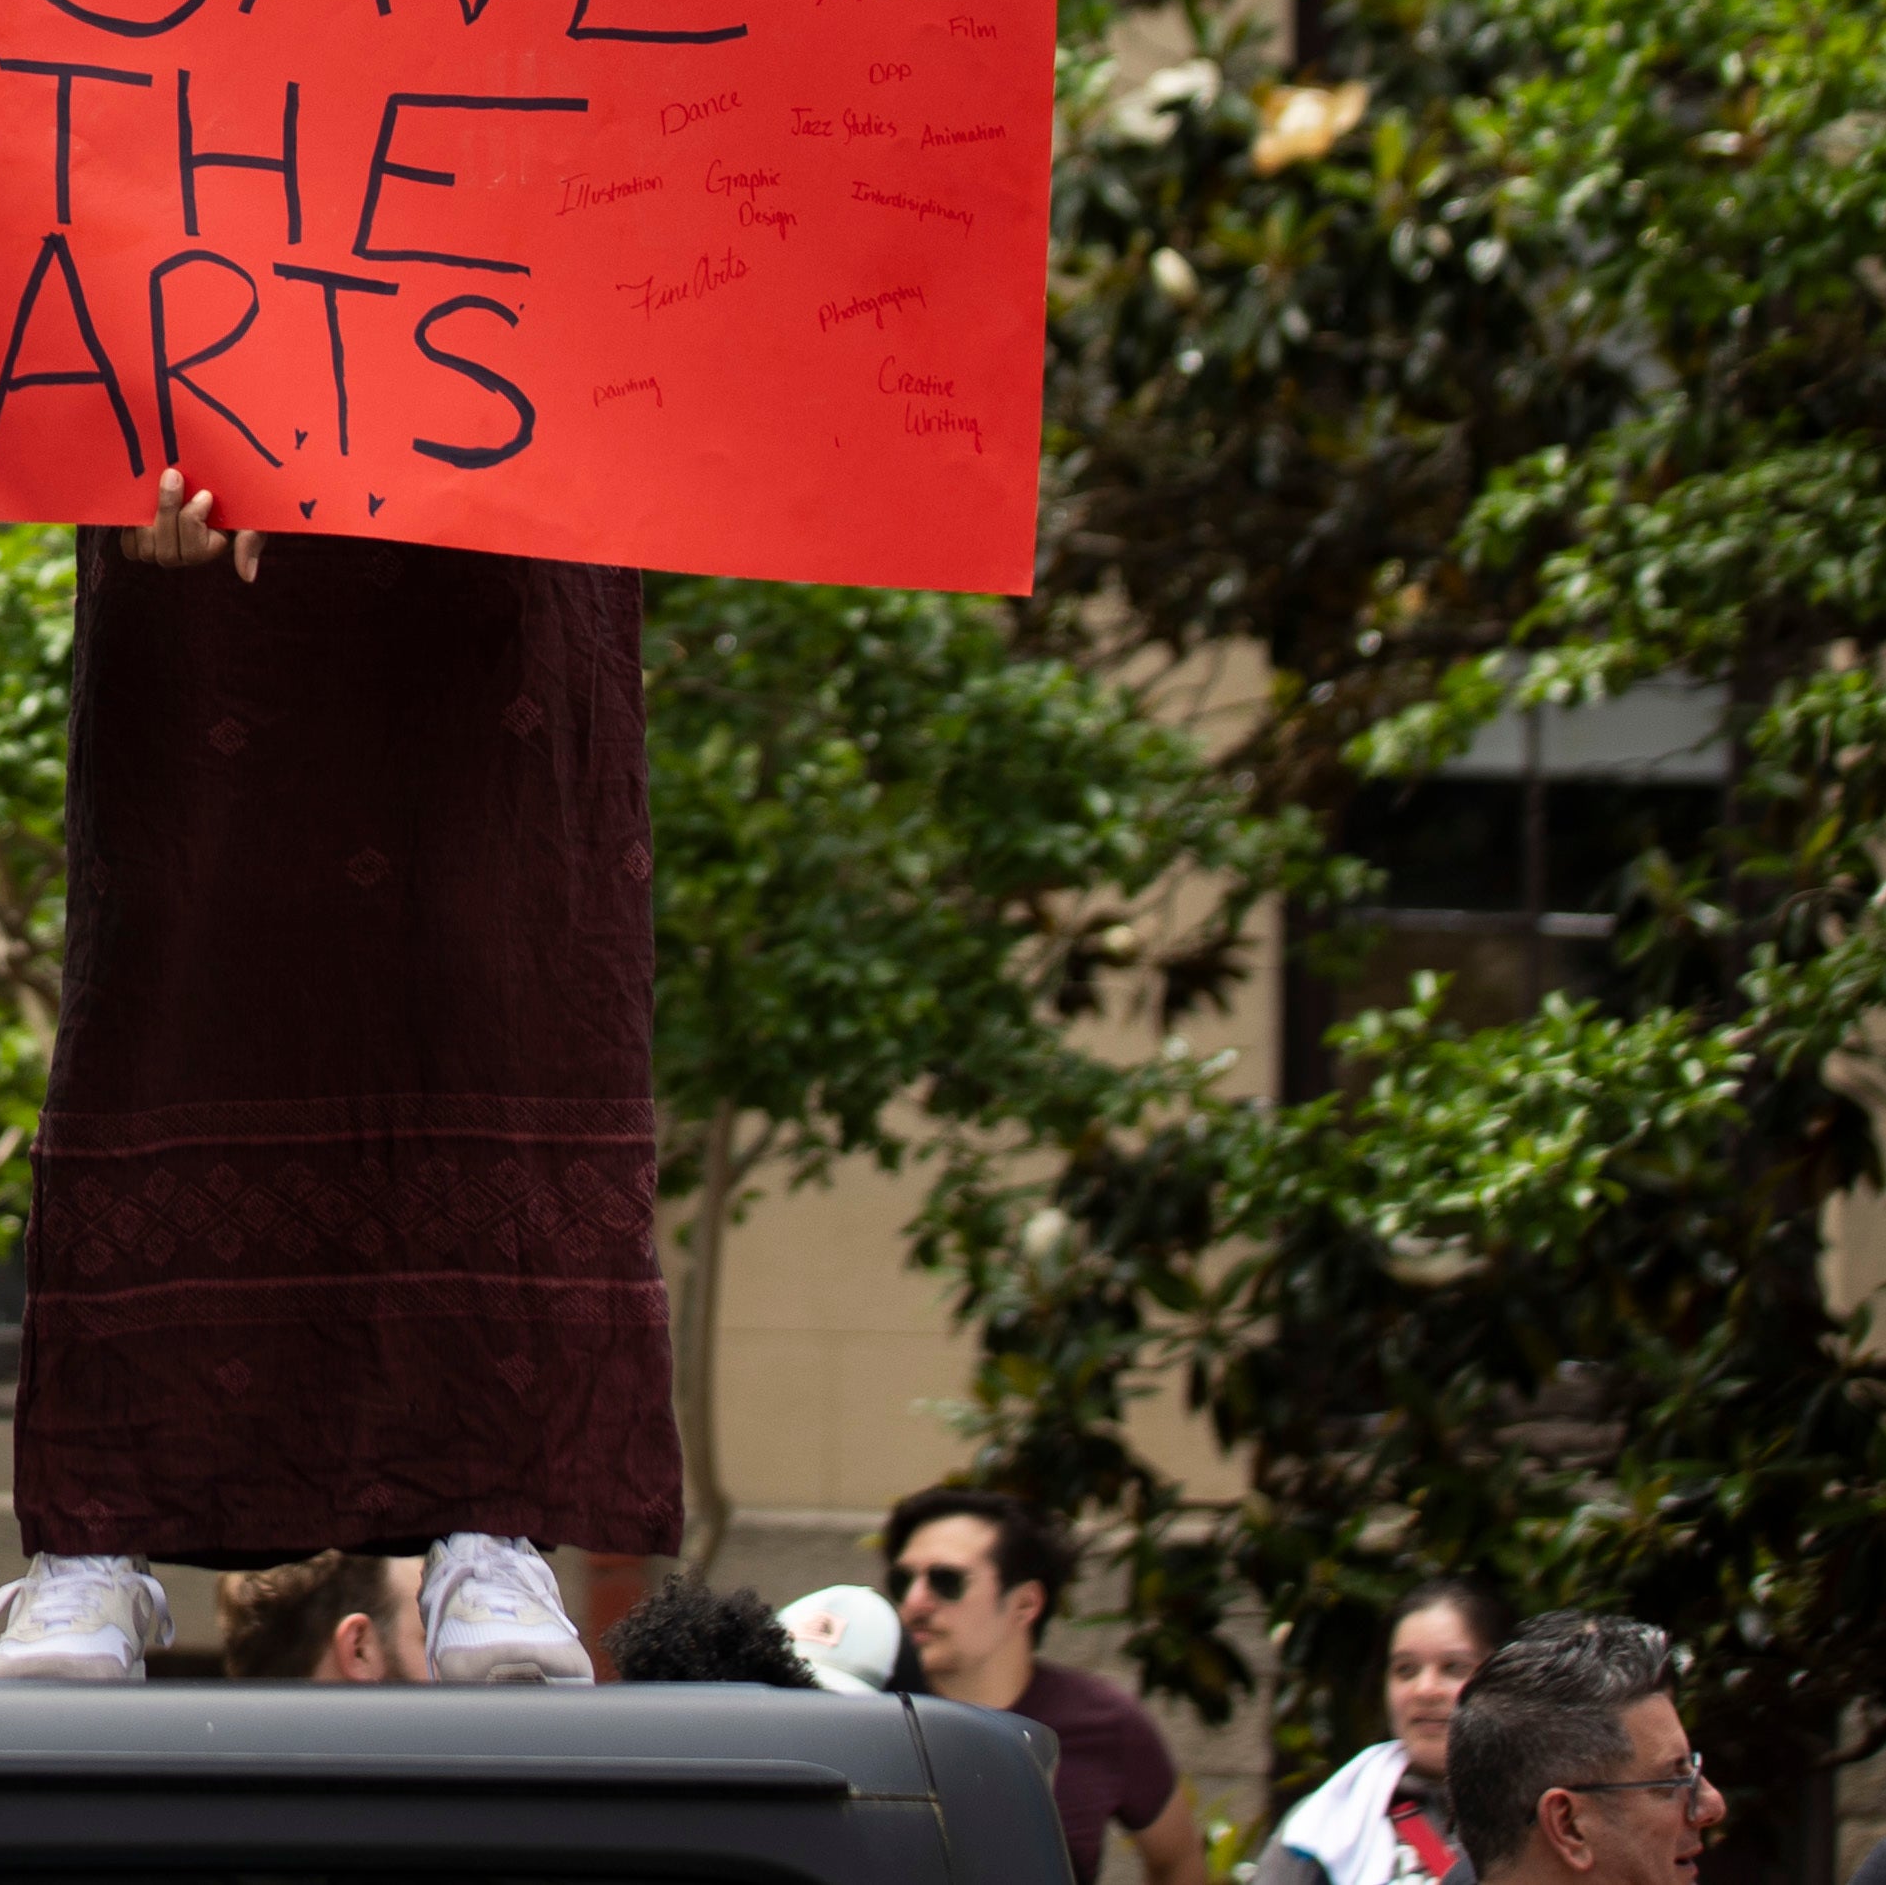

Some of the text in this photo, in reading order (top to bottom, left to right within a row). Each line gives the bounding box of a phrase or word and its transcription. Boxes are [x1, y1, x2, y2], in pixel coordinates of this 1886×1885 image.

[948, 17, 997, 39] Film
[660, 91, 743, 136] Dance
[791, 107, 833, 137] Jazz
[920, 121, 1006, 150] Animation
[704, 159, 781, 201] Graphic
[739, 203, 798, 239] Design
[878, 355, 955, 398] Creative
